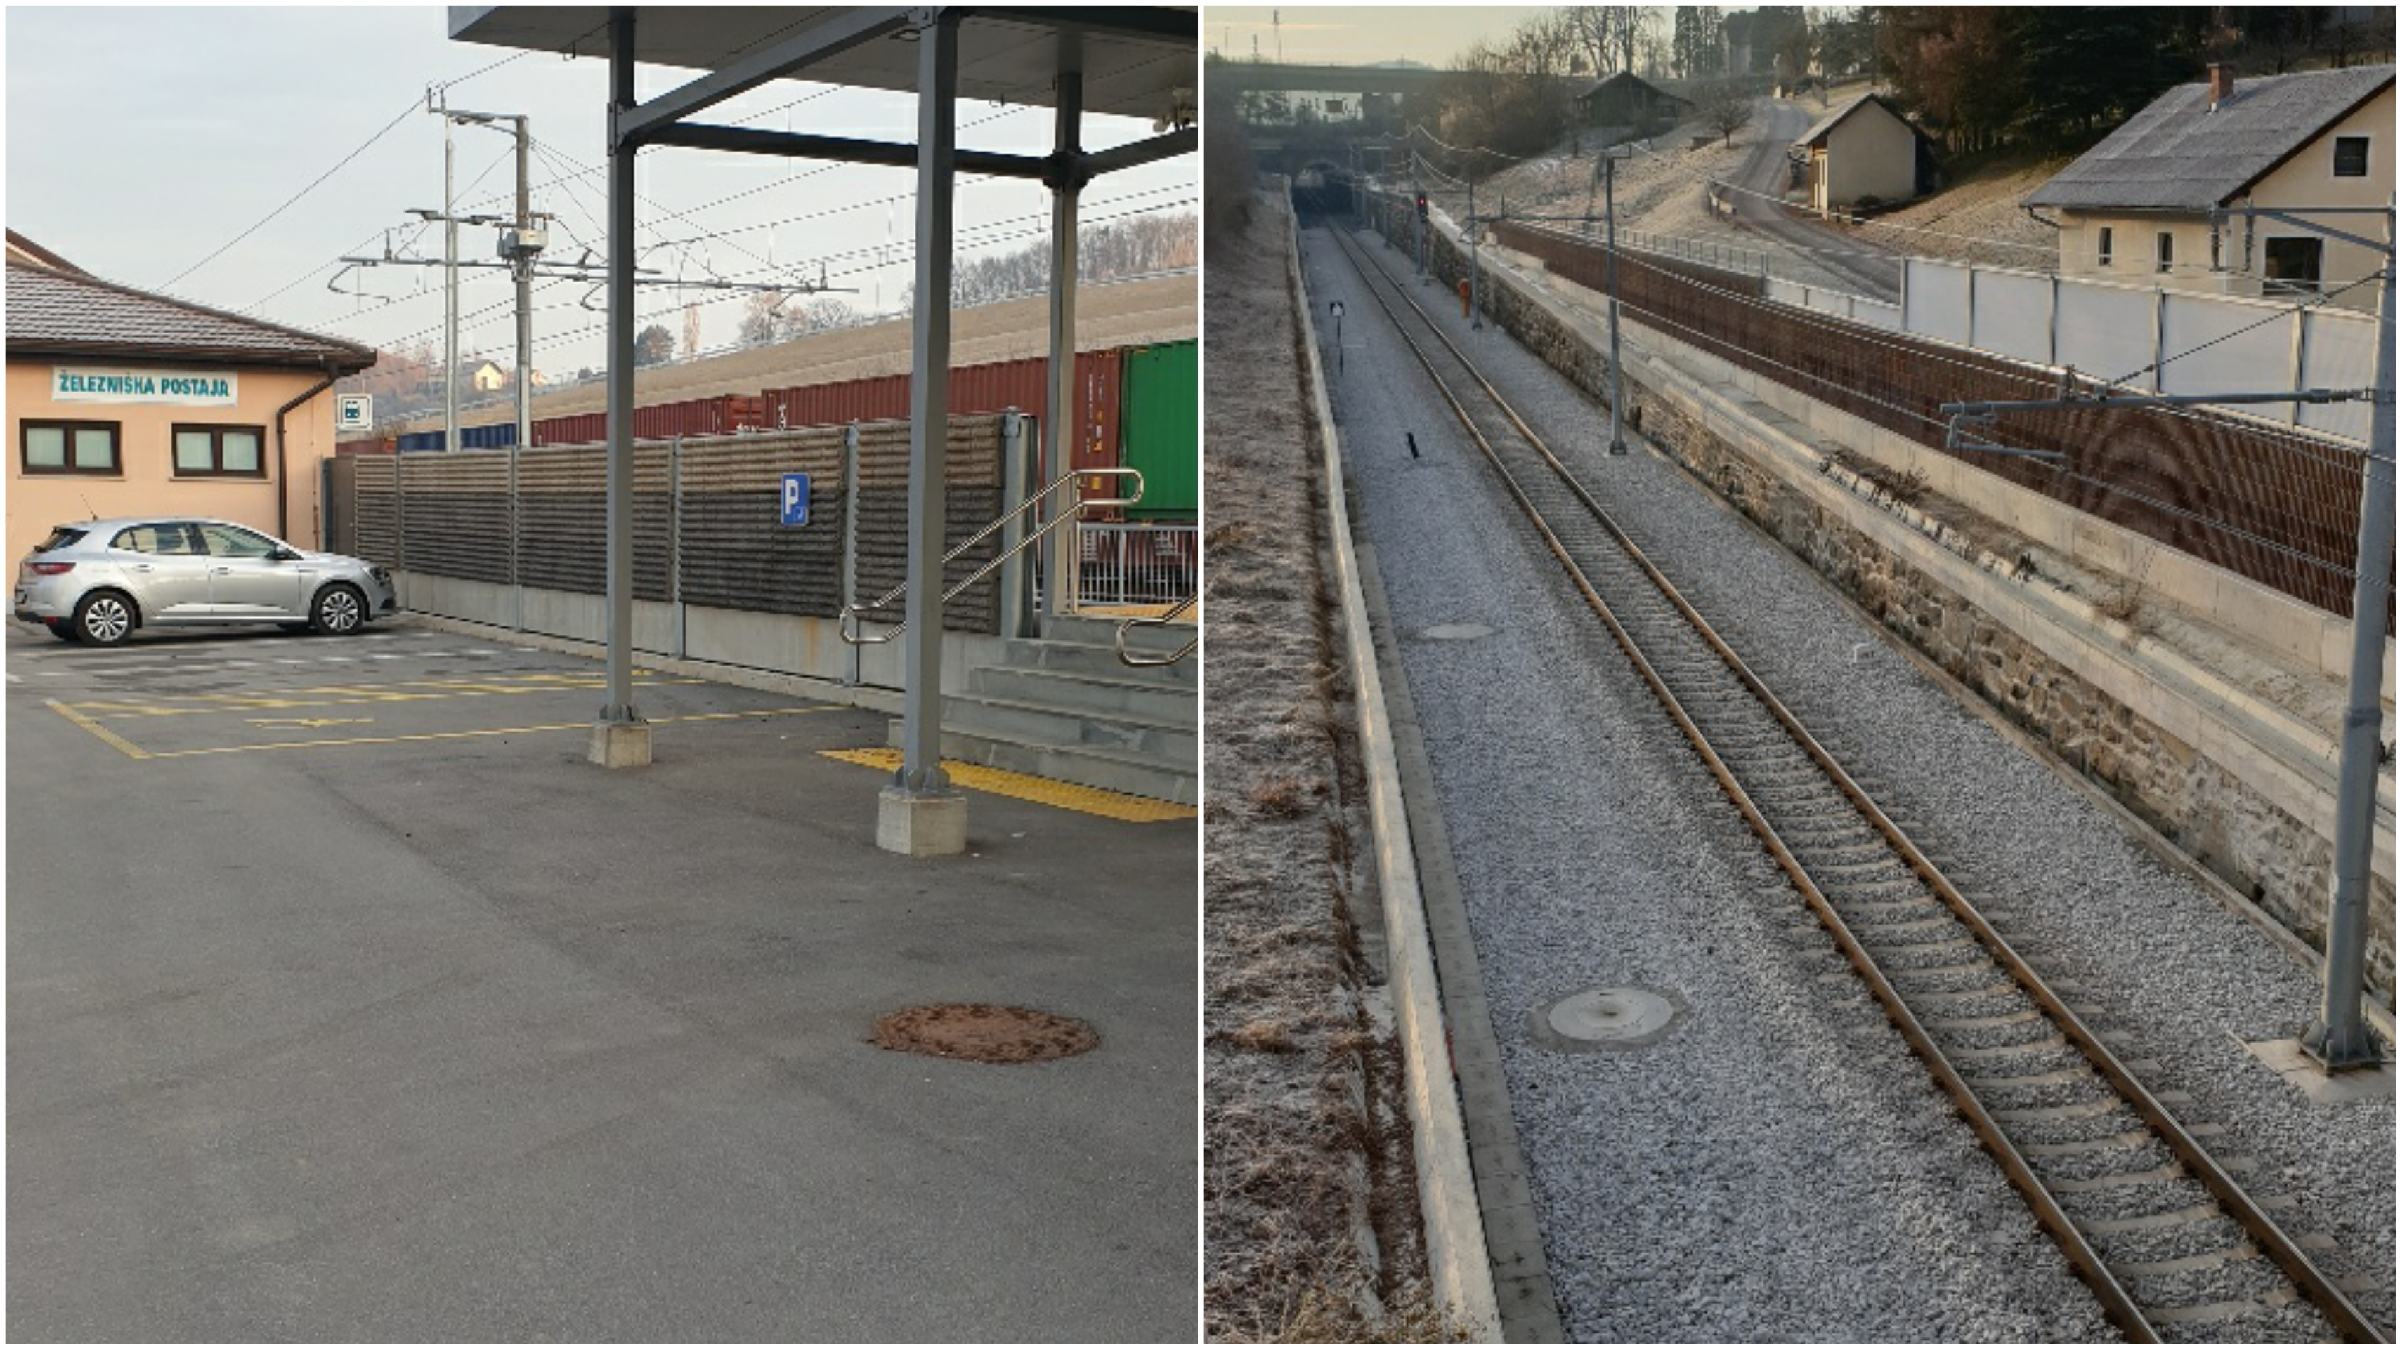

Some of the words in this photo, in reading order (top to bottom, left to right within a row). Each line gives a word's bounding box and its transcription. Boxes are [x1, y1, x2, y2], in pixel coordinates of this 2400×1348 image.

[59, 370, 155, 395] ŽELEZNIŠKA
[161, 377, 229, 397] POSTAJA
[785, 479, 799, 515] P
